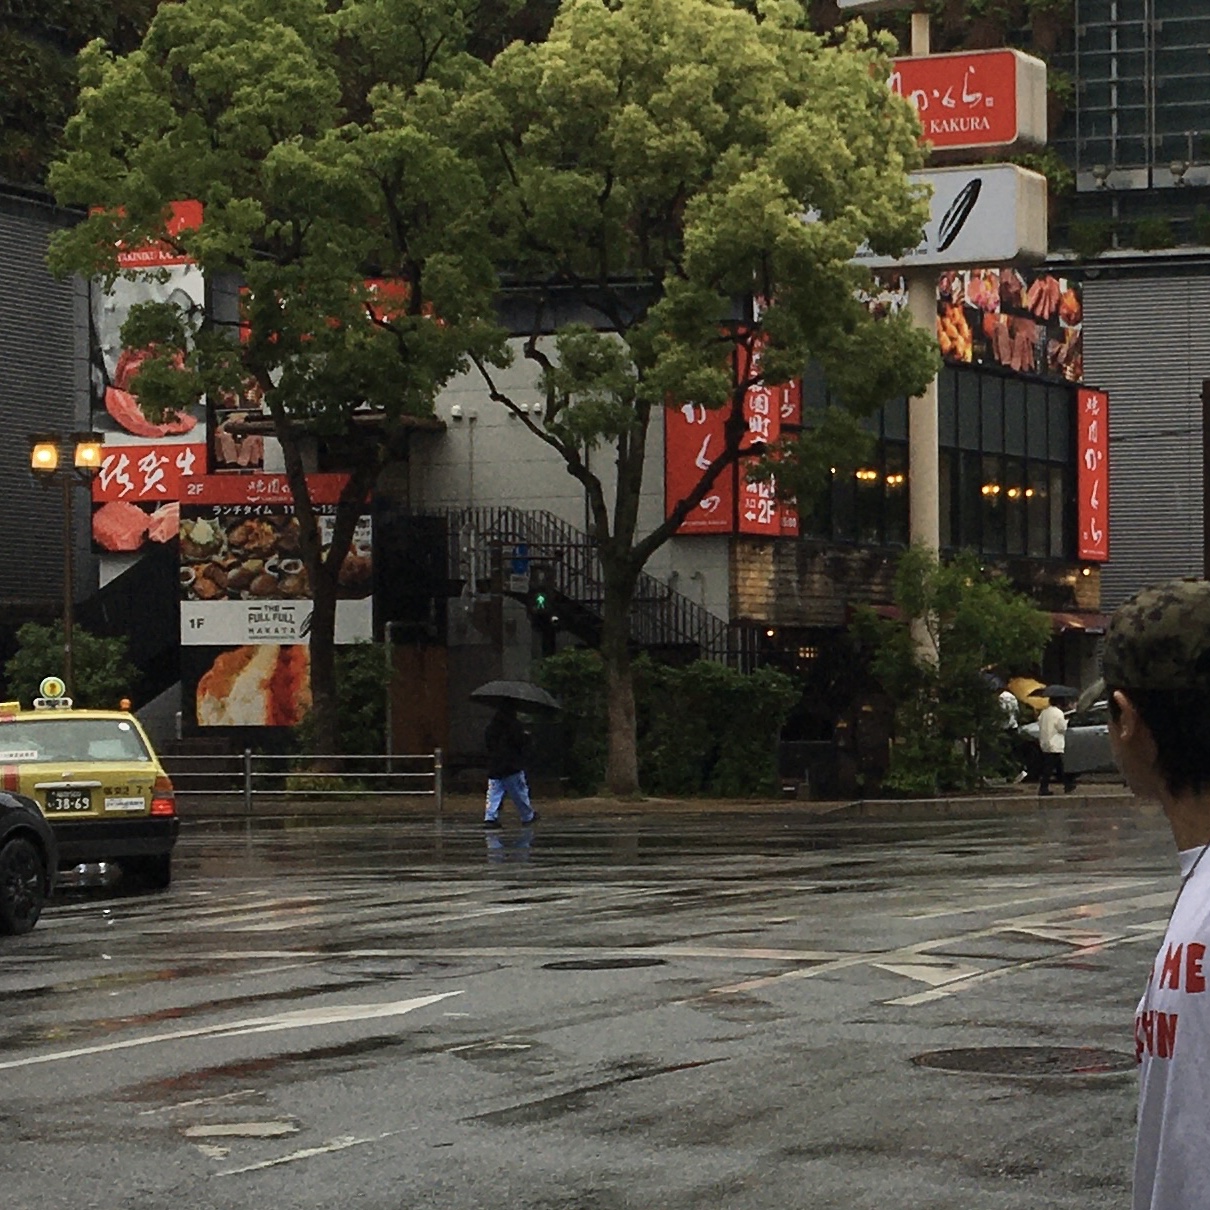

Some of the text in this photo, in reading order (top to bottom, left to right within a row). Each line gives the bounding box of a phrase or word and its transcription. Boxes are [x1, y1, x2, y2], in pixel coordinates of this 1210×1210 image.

[930, 117, 990, 134] KAKURA
[187, 483, 204, 495] 2F
[212, 505, 273, 515] ランチタイム
[758, 499, 775, 523] 2F
[189, 618, 205, 629] 1F
[248, 613, 295, 625] FULL FULL
